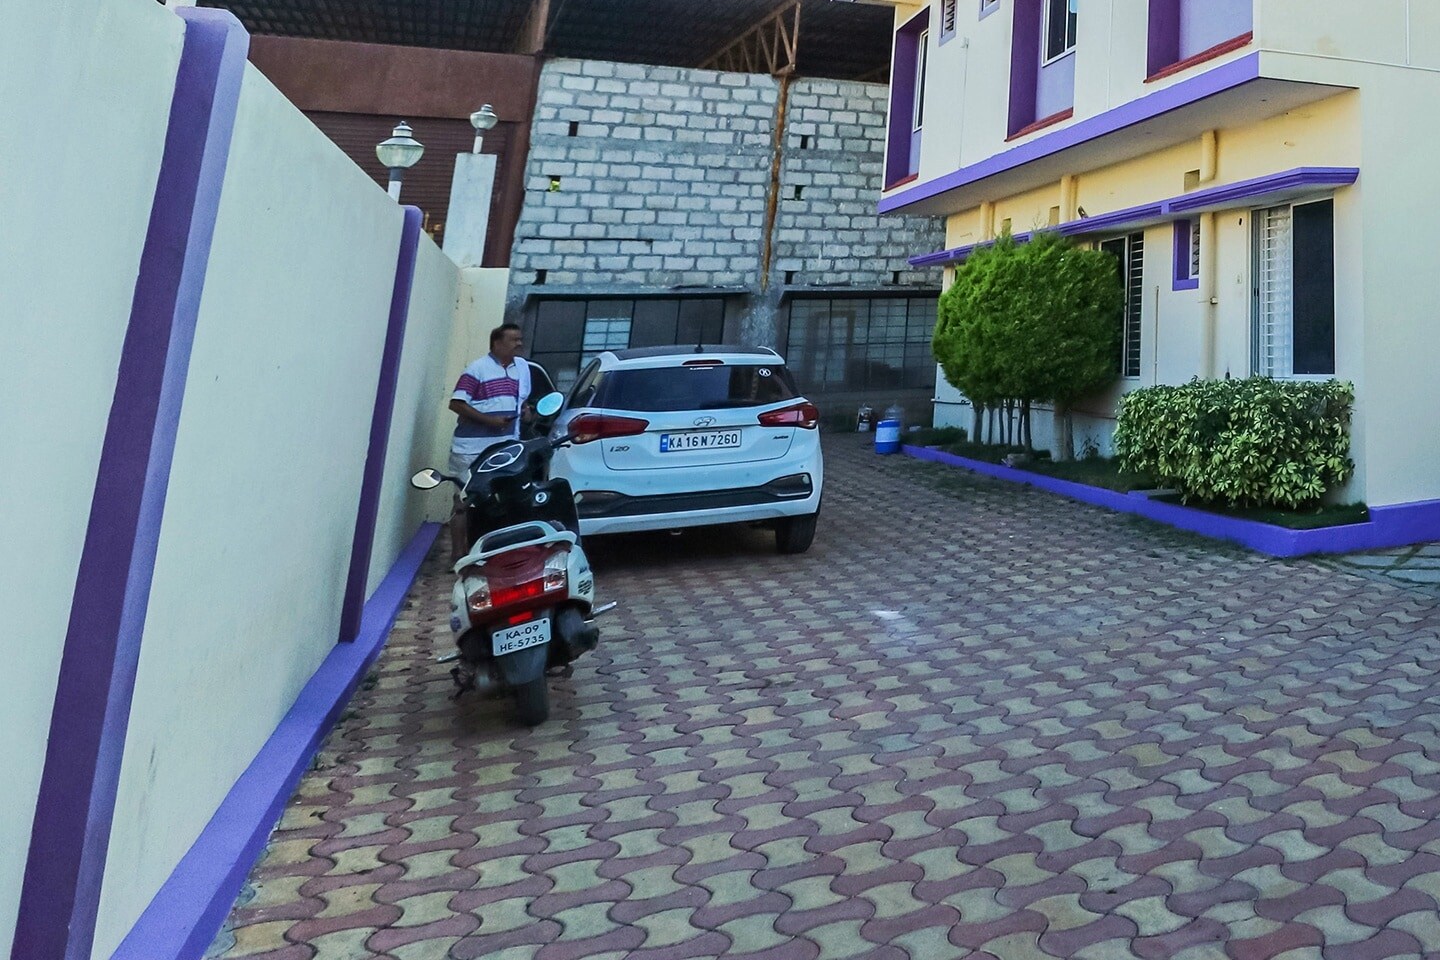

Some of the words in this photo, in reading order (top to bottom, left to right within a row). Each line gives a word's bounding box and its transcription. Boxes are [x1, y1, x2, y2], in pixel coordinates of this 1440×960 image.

[669, 437, 682, 448] KA
[686, 436, 698, 447] 16
[701, 435, 708, 446] N
[710, 433, 738, 445] 7260
[505, 624, 539, 639] KA-09
[500, 635, 544, 652] HE-5735
